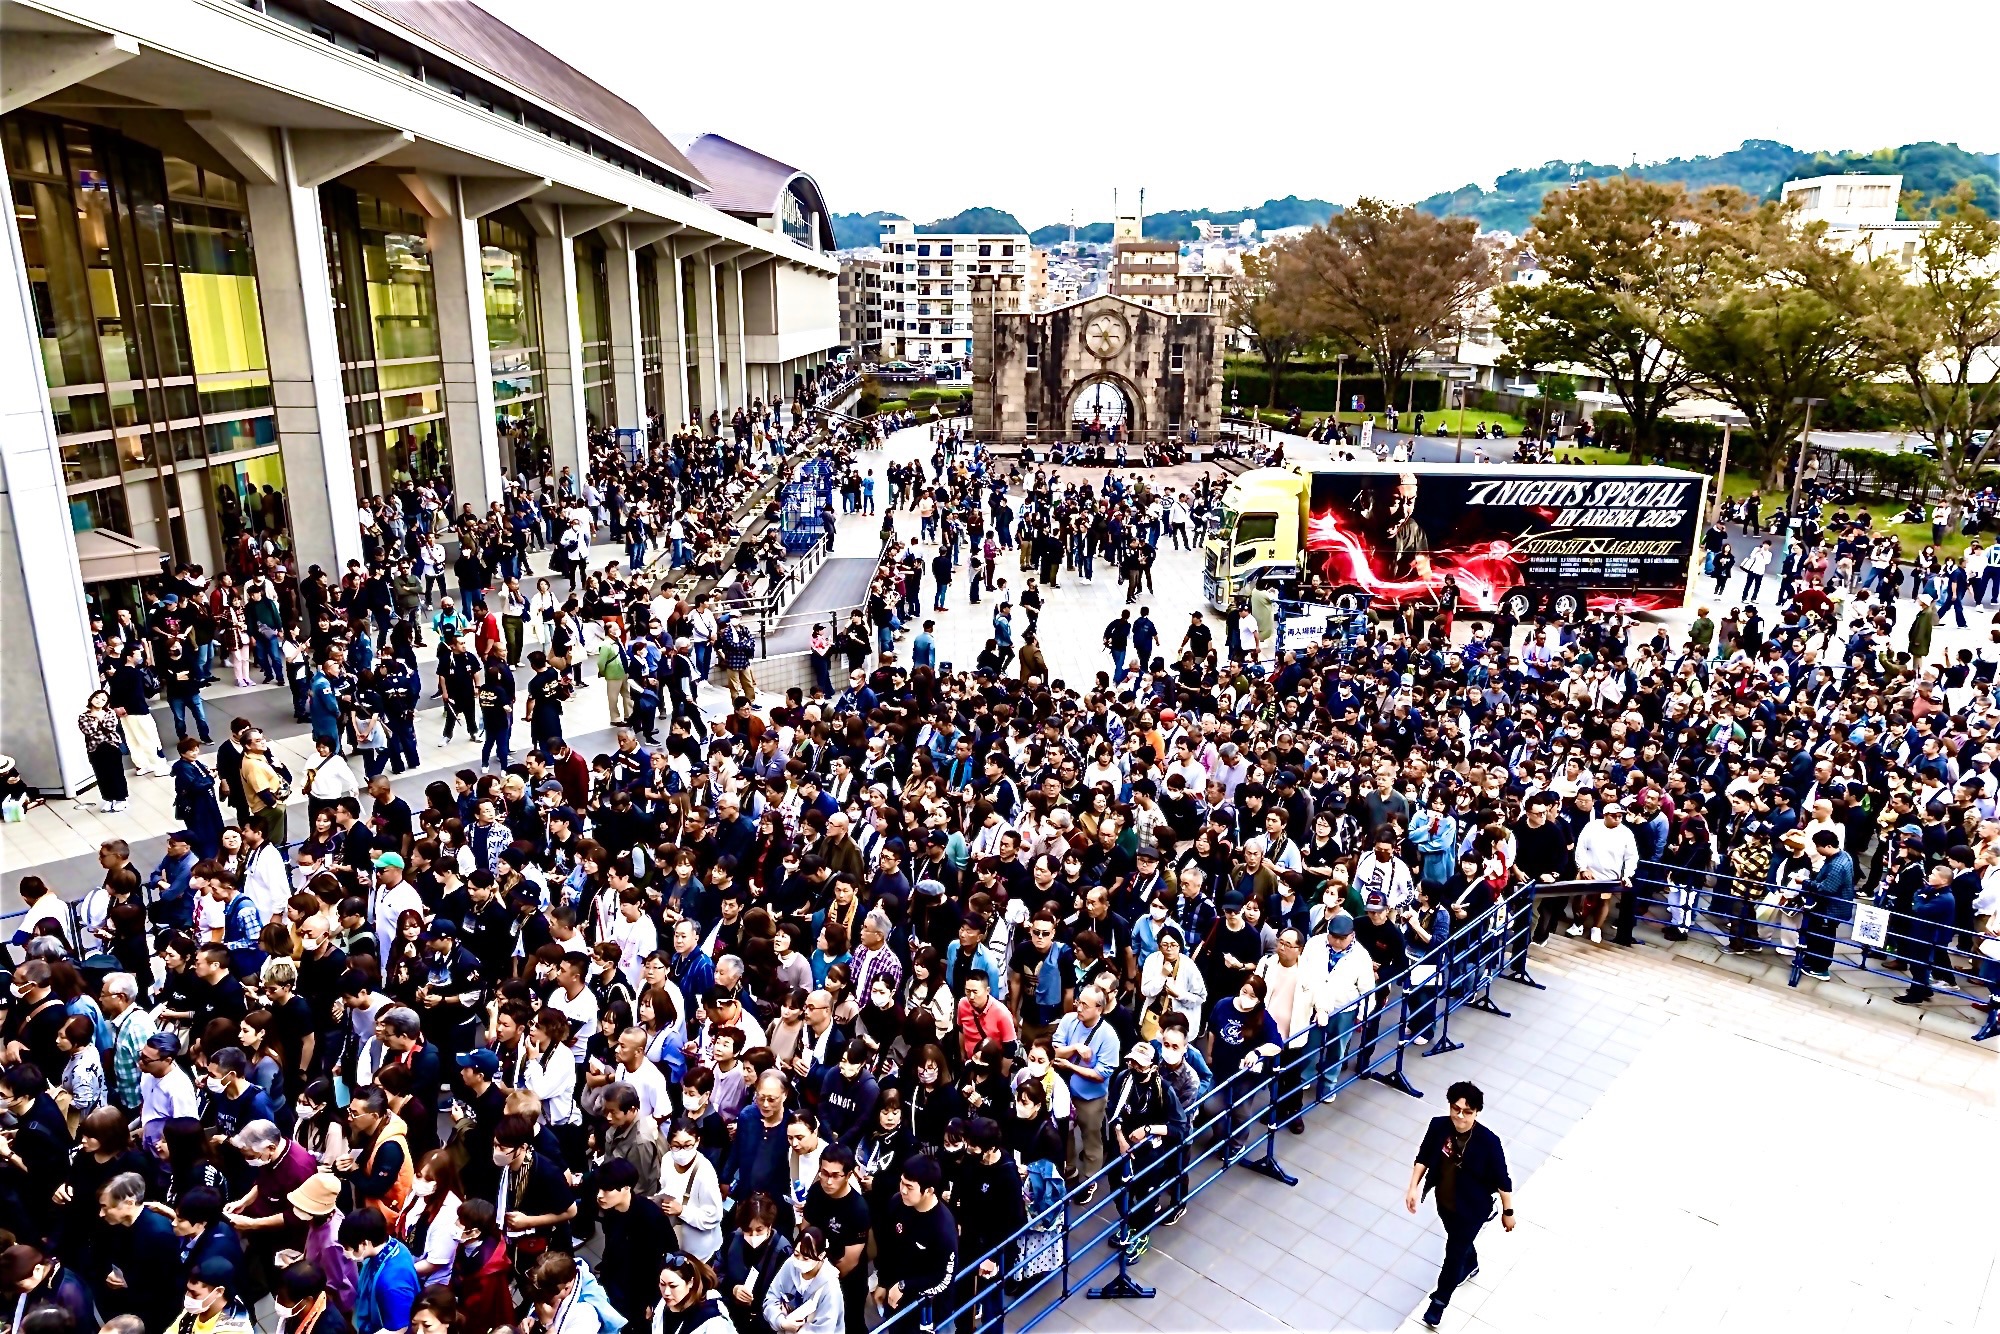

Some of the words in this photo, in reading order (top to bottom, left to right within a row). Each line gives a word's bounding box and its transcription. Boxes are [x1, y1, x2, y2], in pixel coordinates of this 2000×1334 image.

[1466, 481, 1499, 505] 7
[1491, 481, 1592, 507] NIGHTS
[1584, 482, 1692, 508] SPECIAL
[1551, 508, 1582, 527] IN
[1573, 508, 1637, 528] ARENA
[1636, 509, 1688, 528] 2025
[1287, 626, 1323, 636] 再入場禁止
